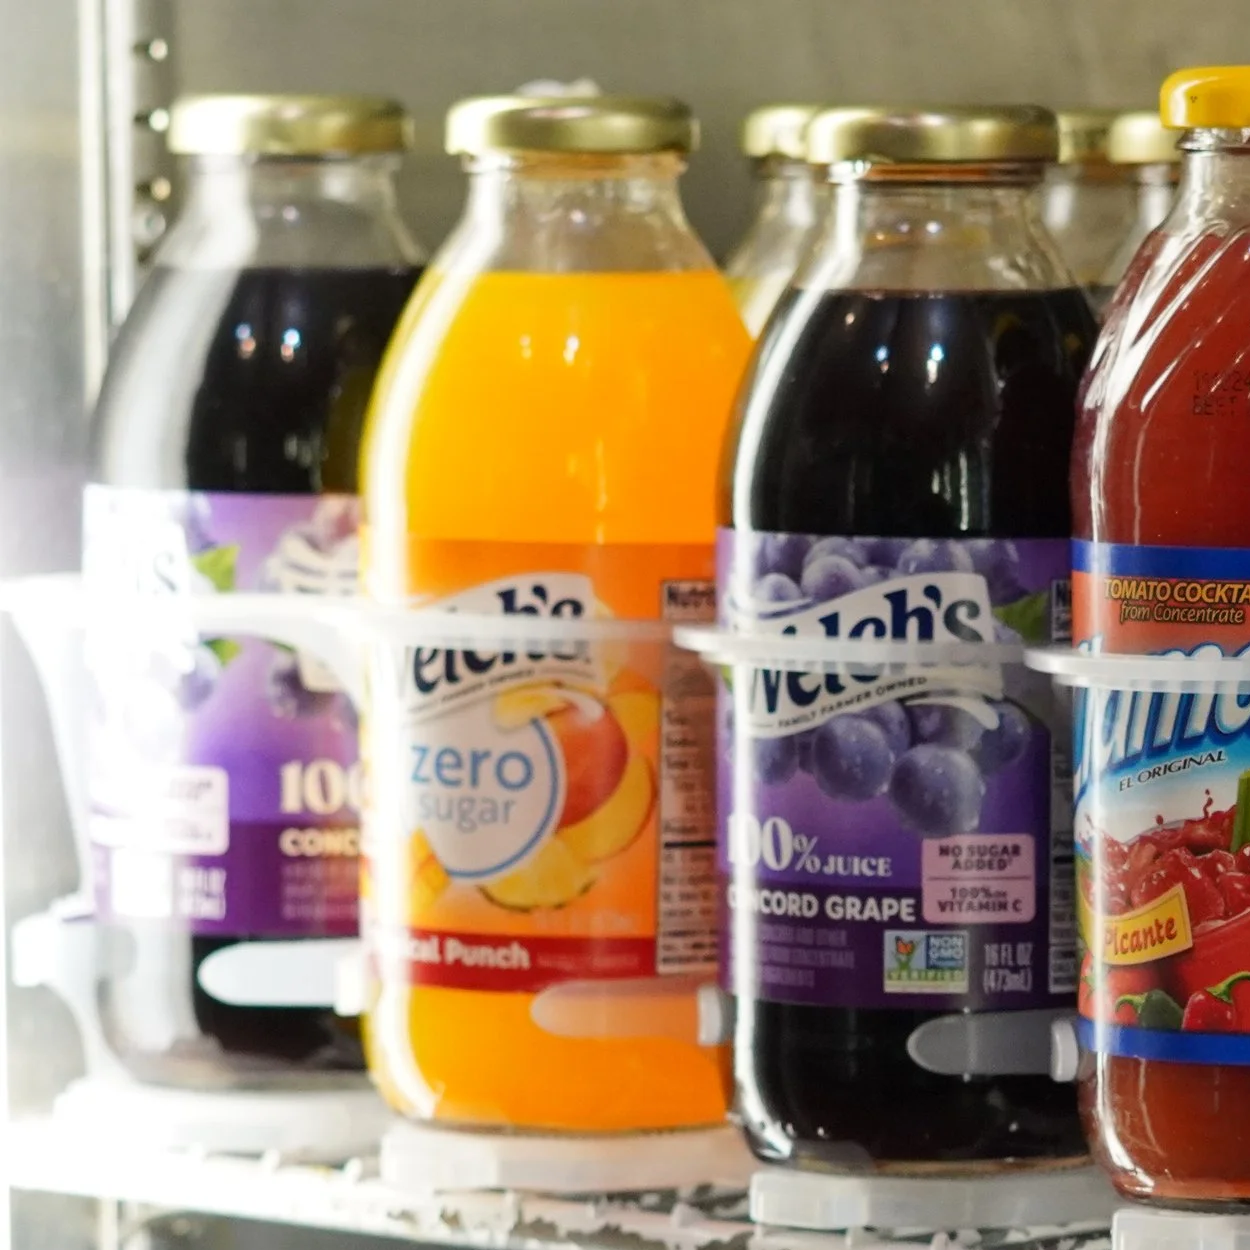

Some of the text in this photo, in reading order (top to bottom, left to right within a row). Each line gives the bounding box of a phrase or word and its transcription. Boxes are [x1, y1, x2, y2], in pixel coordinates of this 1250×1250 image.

[1103, 577, 1171, 602] TOMATO
[1119, 601, 1245, 625] from Concentrate
[411, 745, 534, 792] zero
[1136, 749, 1228, 787] ORIGINAL
[418, 796, 516, 834] sugar
[967, 843, 1021, 858] SUGAR
[822, 854, 893, 877] JUICE
[824, 893, 917, 922] GRAPE
[937, 899, 1023, 914] VITAMIN C
[444, 937, 531, 970] Punch
